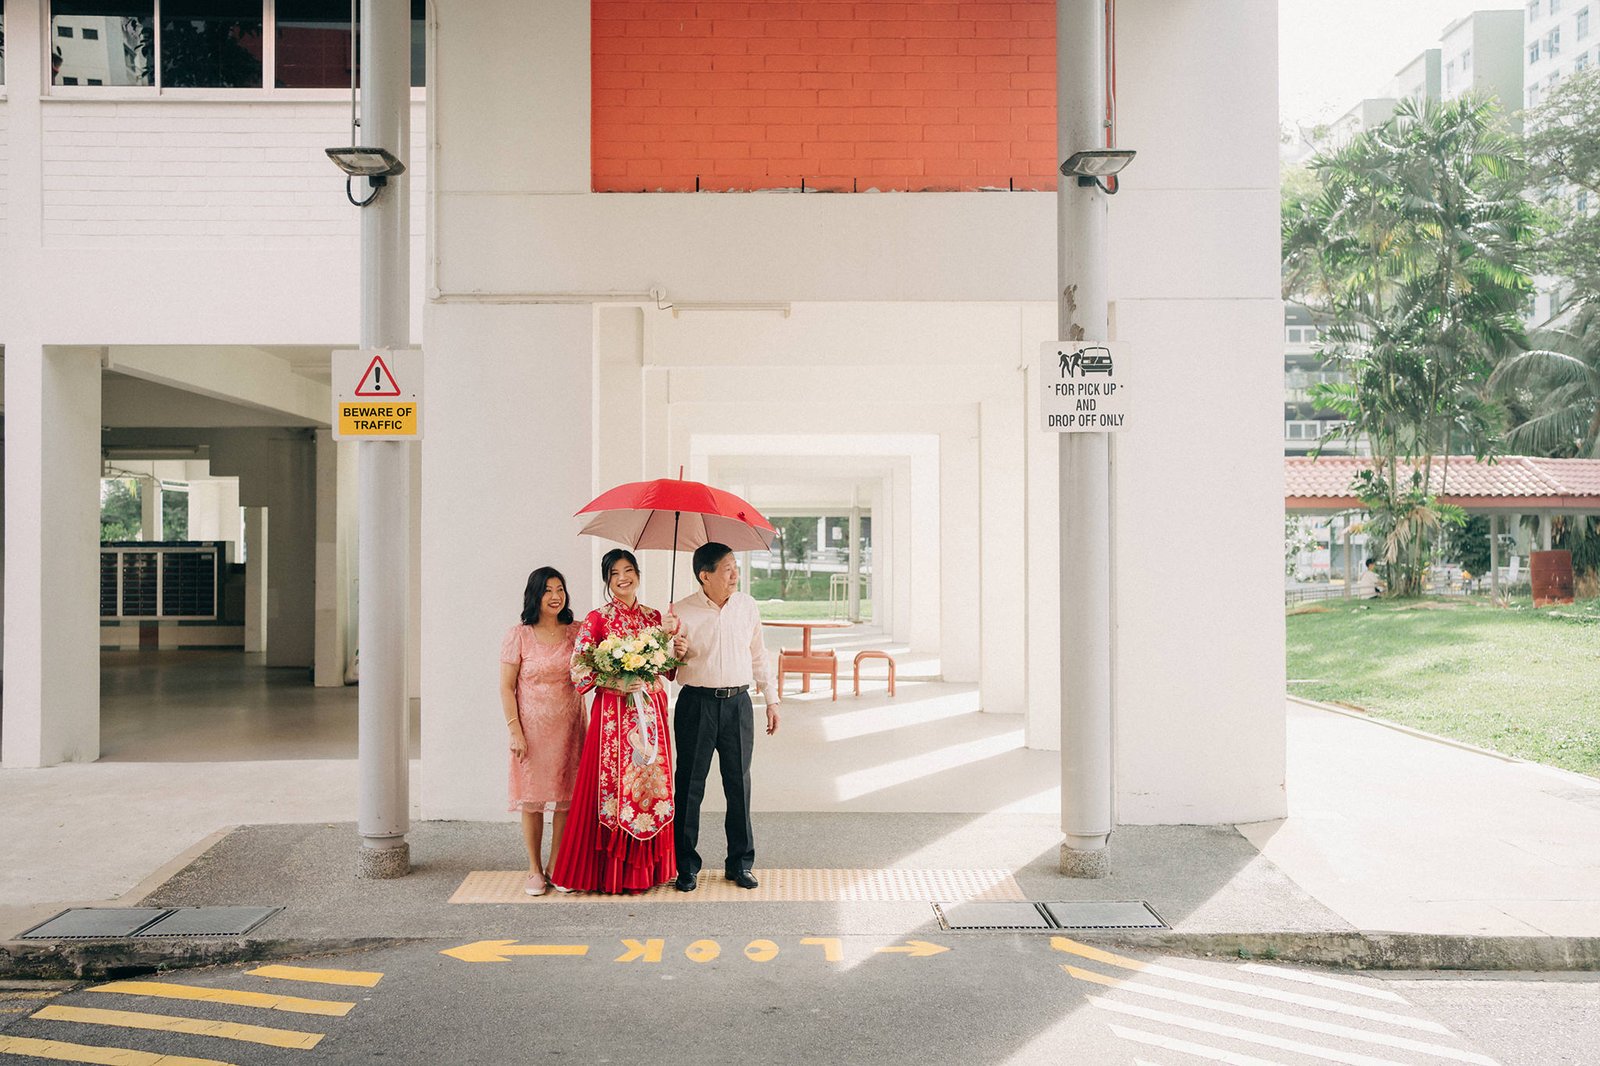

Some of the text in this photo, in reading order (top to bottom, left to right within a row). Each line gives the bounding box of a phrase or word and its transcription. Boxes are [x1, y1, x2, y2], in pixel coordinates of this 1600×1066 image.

[1055, 383, 1117, 396] FOR PICK UP
[1076, 398, 1096, 411] AND
[343, 408, 412, 417] BEWARE OF
[353, 420, 403, 430] TRAFFIC
[1048, 414, 1125, 427] DROP OFF ONLY
[613, 937, 844, 962] LOOK
